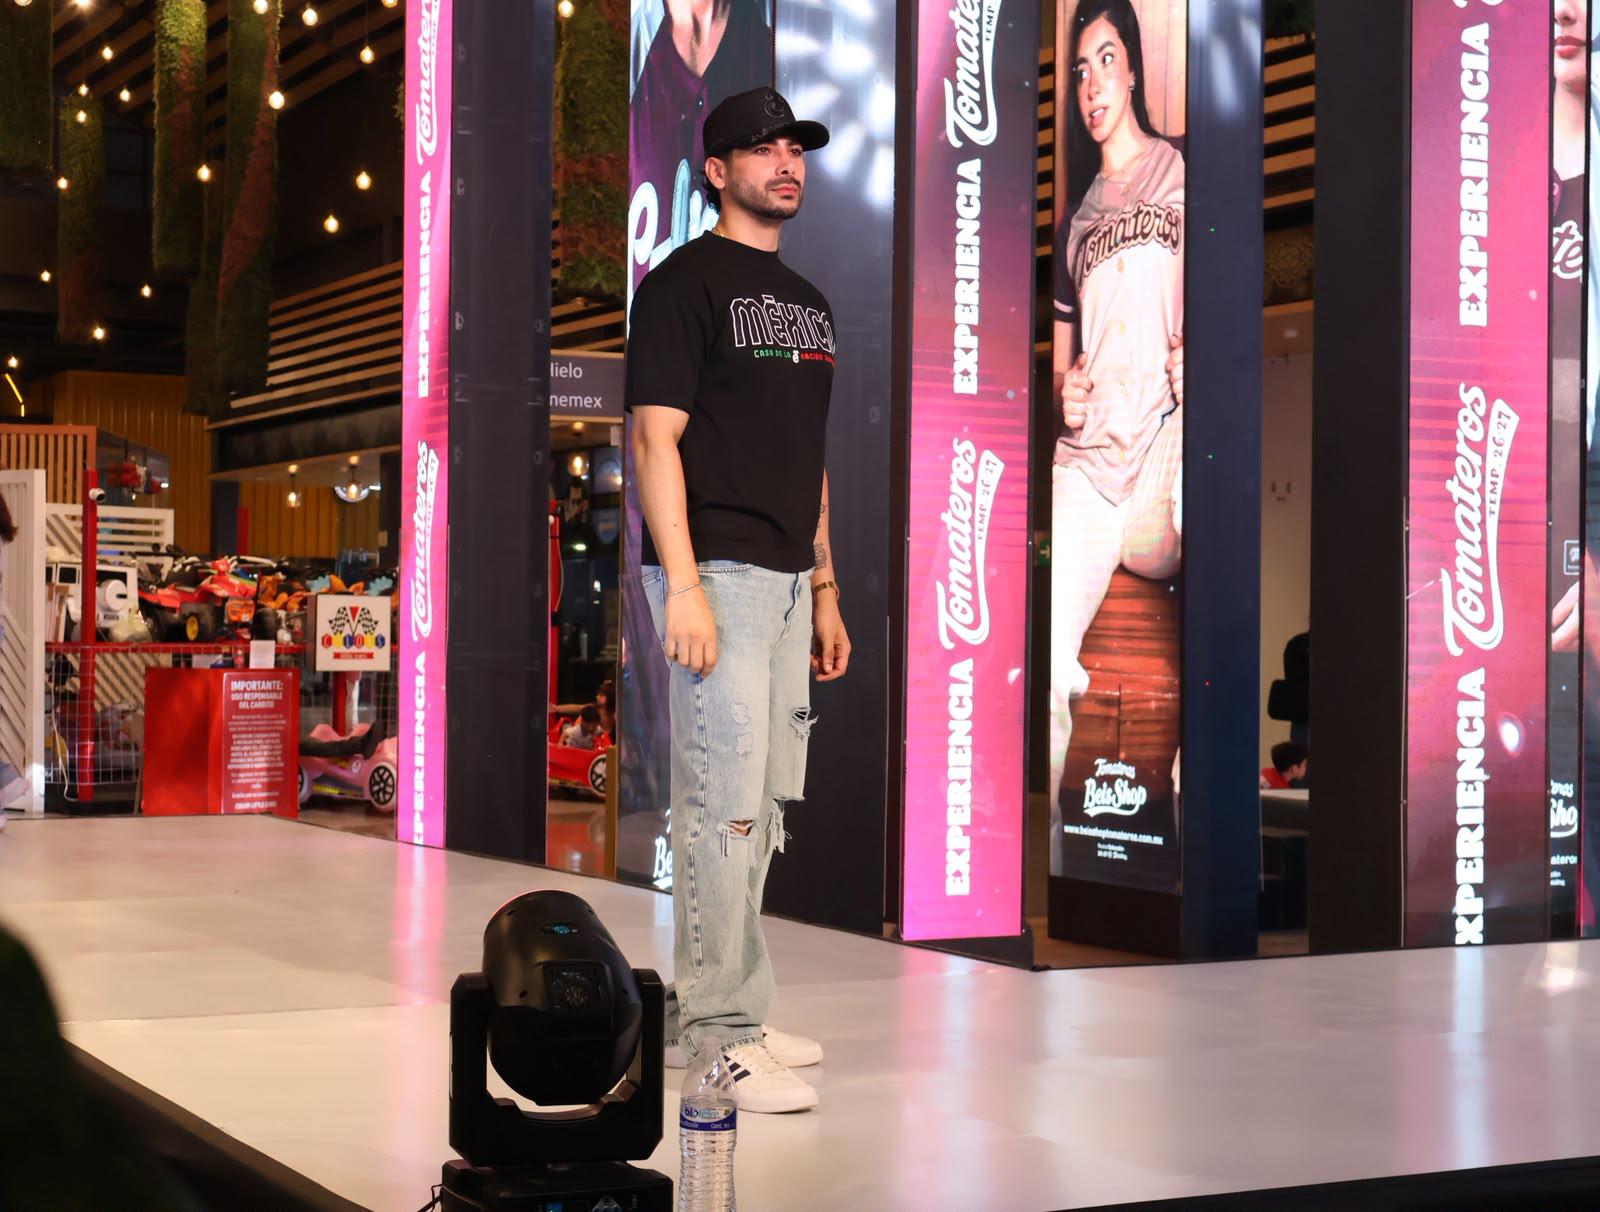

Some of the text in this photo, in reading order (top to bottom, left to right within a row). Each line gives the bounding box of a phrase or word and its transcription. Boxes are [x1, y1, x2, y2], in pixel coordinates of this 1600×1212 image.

[416, 0, 439, 165] Tomater
[1459, 22, 1490, 327] EXPERIENCIA
[418, 170, 431, 398] EXPERIENCIA
[953, 158, 982, 395] EXPERIENCIA
[1071, 200, 1181, 292] Tomateros
[411, 440, 433, 642] Tomateros
[936, 437, 990, 650] Tomateros
[1440, 381, 1504, 657] Tomateros
[231, 680, 284, 692] IMPORTANTE:
[945, 657, 974, 896] EXPERIENCIA
[1094, 758, 1136, 780] Tomateros
